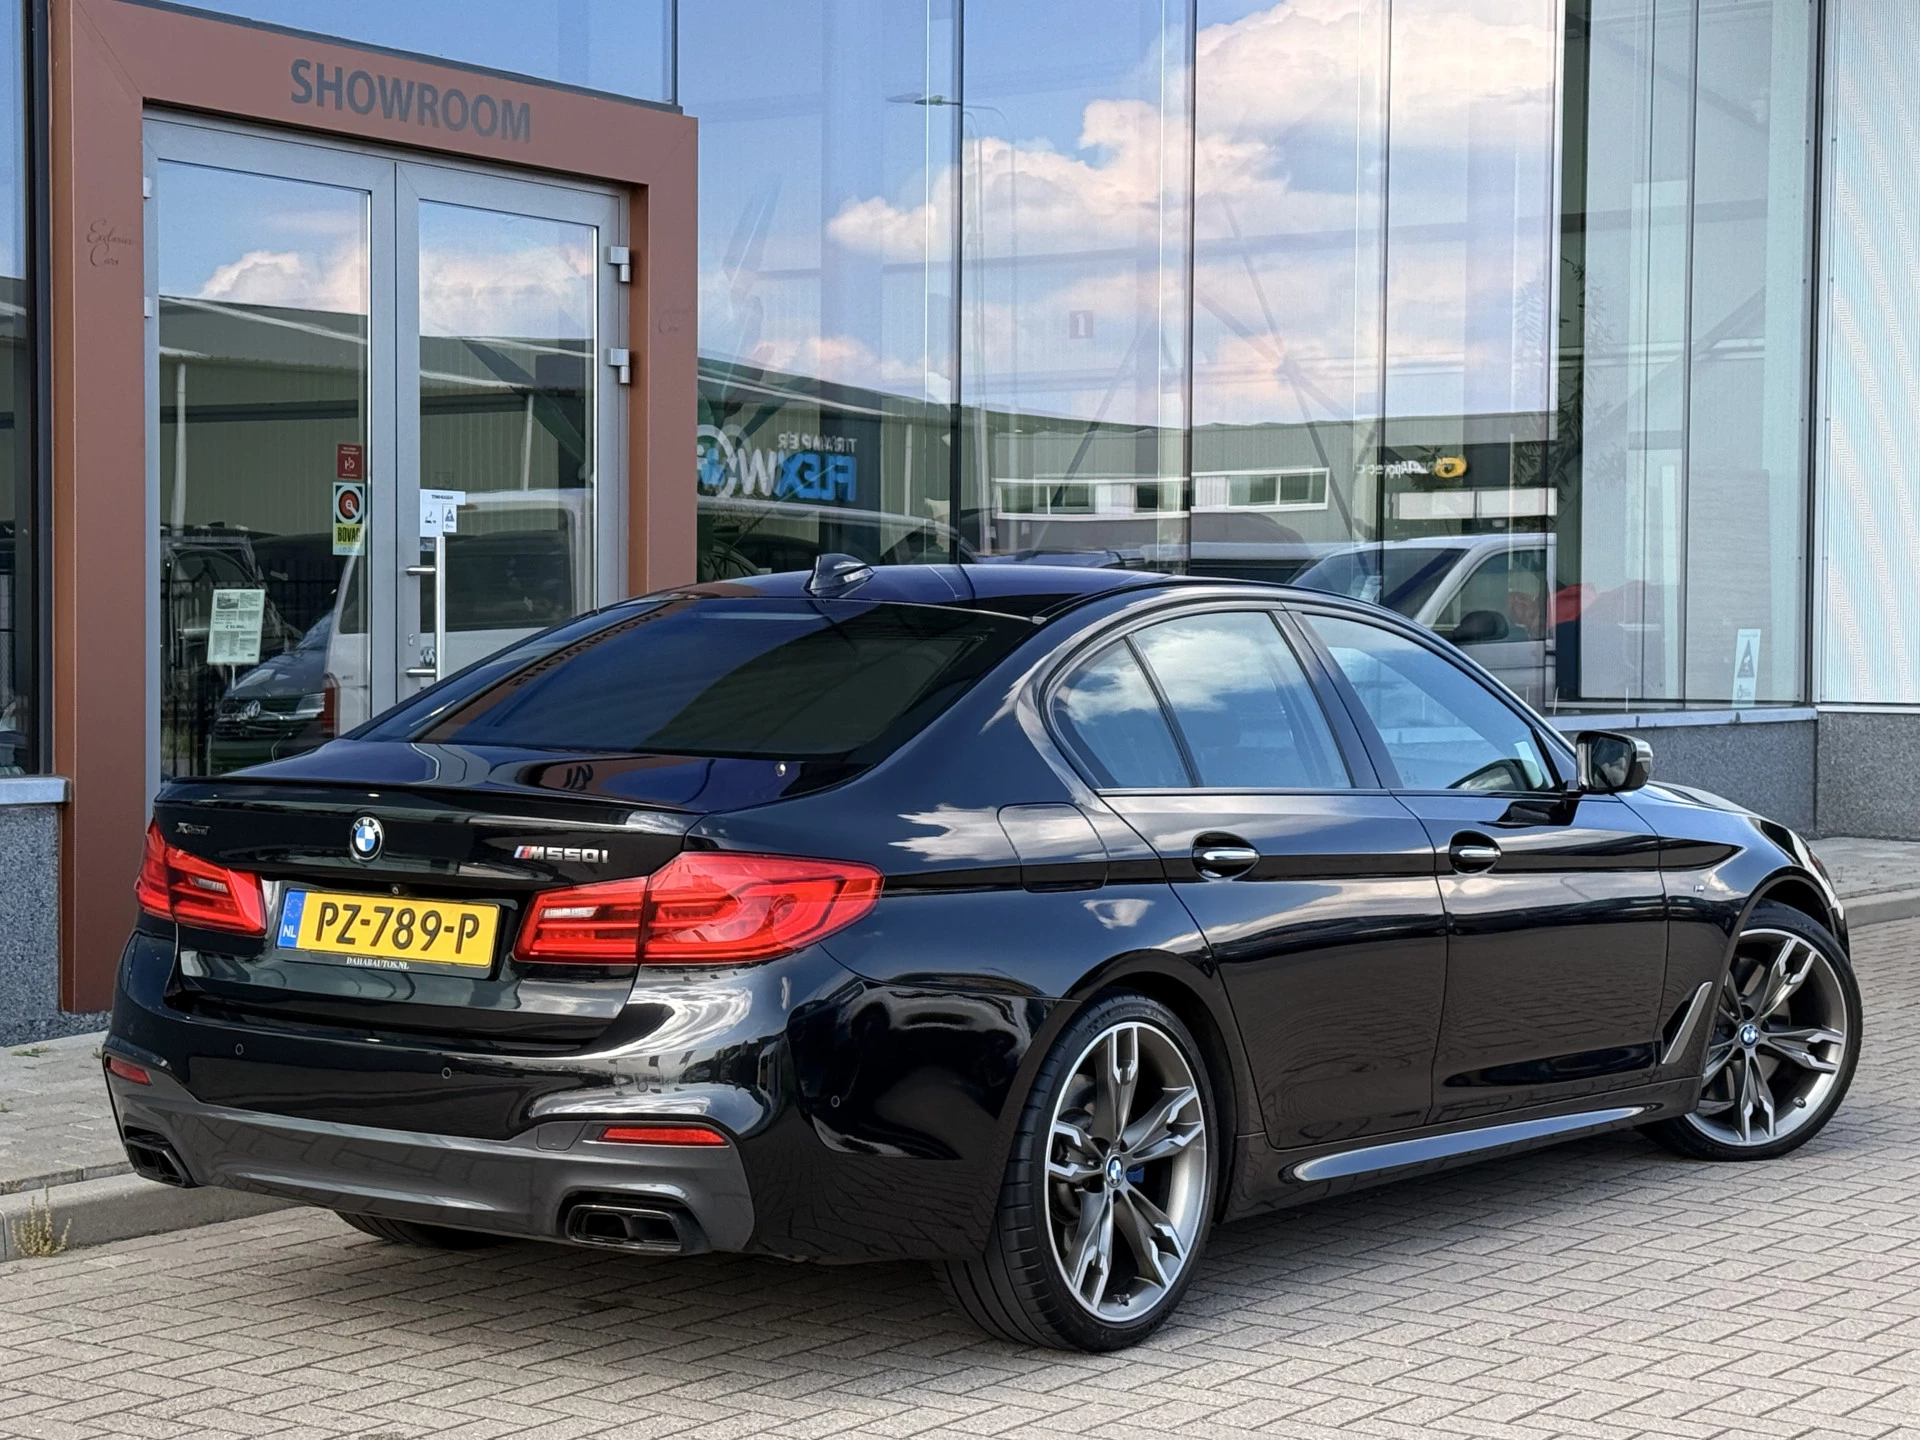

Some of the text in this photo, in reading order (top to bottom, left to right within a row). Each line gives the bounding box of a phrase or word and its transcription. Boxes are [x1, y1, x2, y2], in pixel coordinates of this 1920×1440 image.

[290, 58, 531, 144] SHOWROOM
[283, 924, 297, 938] NL
[315, 902, 480, 955] PZ-789-P
